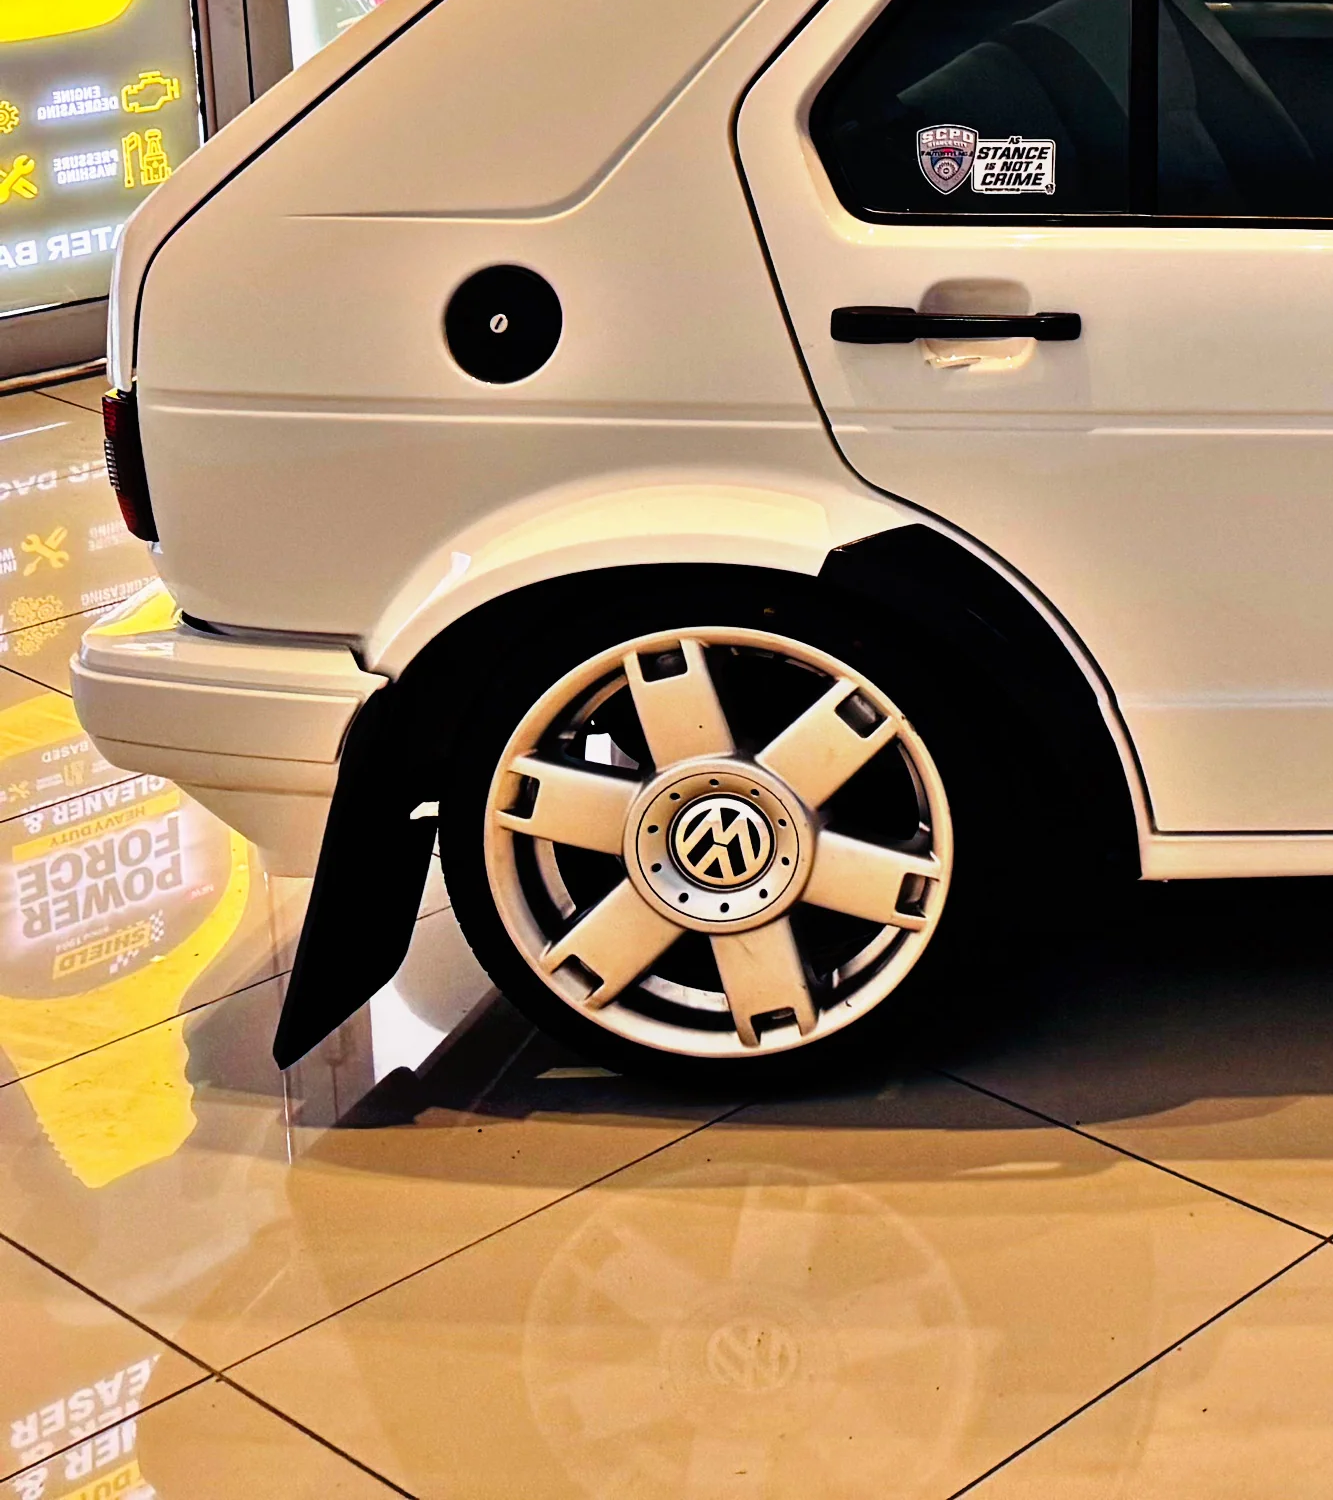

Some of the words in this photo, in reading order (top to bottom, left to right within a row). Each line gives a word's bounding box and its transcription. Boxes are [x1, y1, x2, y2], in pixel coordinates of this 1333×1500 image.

[922, 127, 974, 144] SCPD
[976, 146, 1051, 160] STANCE
[985, 162, 996, 171] IS
[1000, 161, 1031, 172] NOT
[1035, 162, 1043, 171] A
[980, 173, 1046, 186] CRIME
[16, 816, 180, 906] FORCE
[19, 852, 182, 940] POWER
[59, 929, 146, 971] SHIELD
